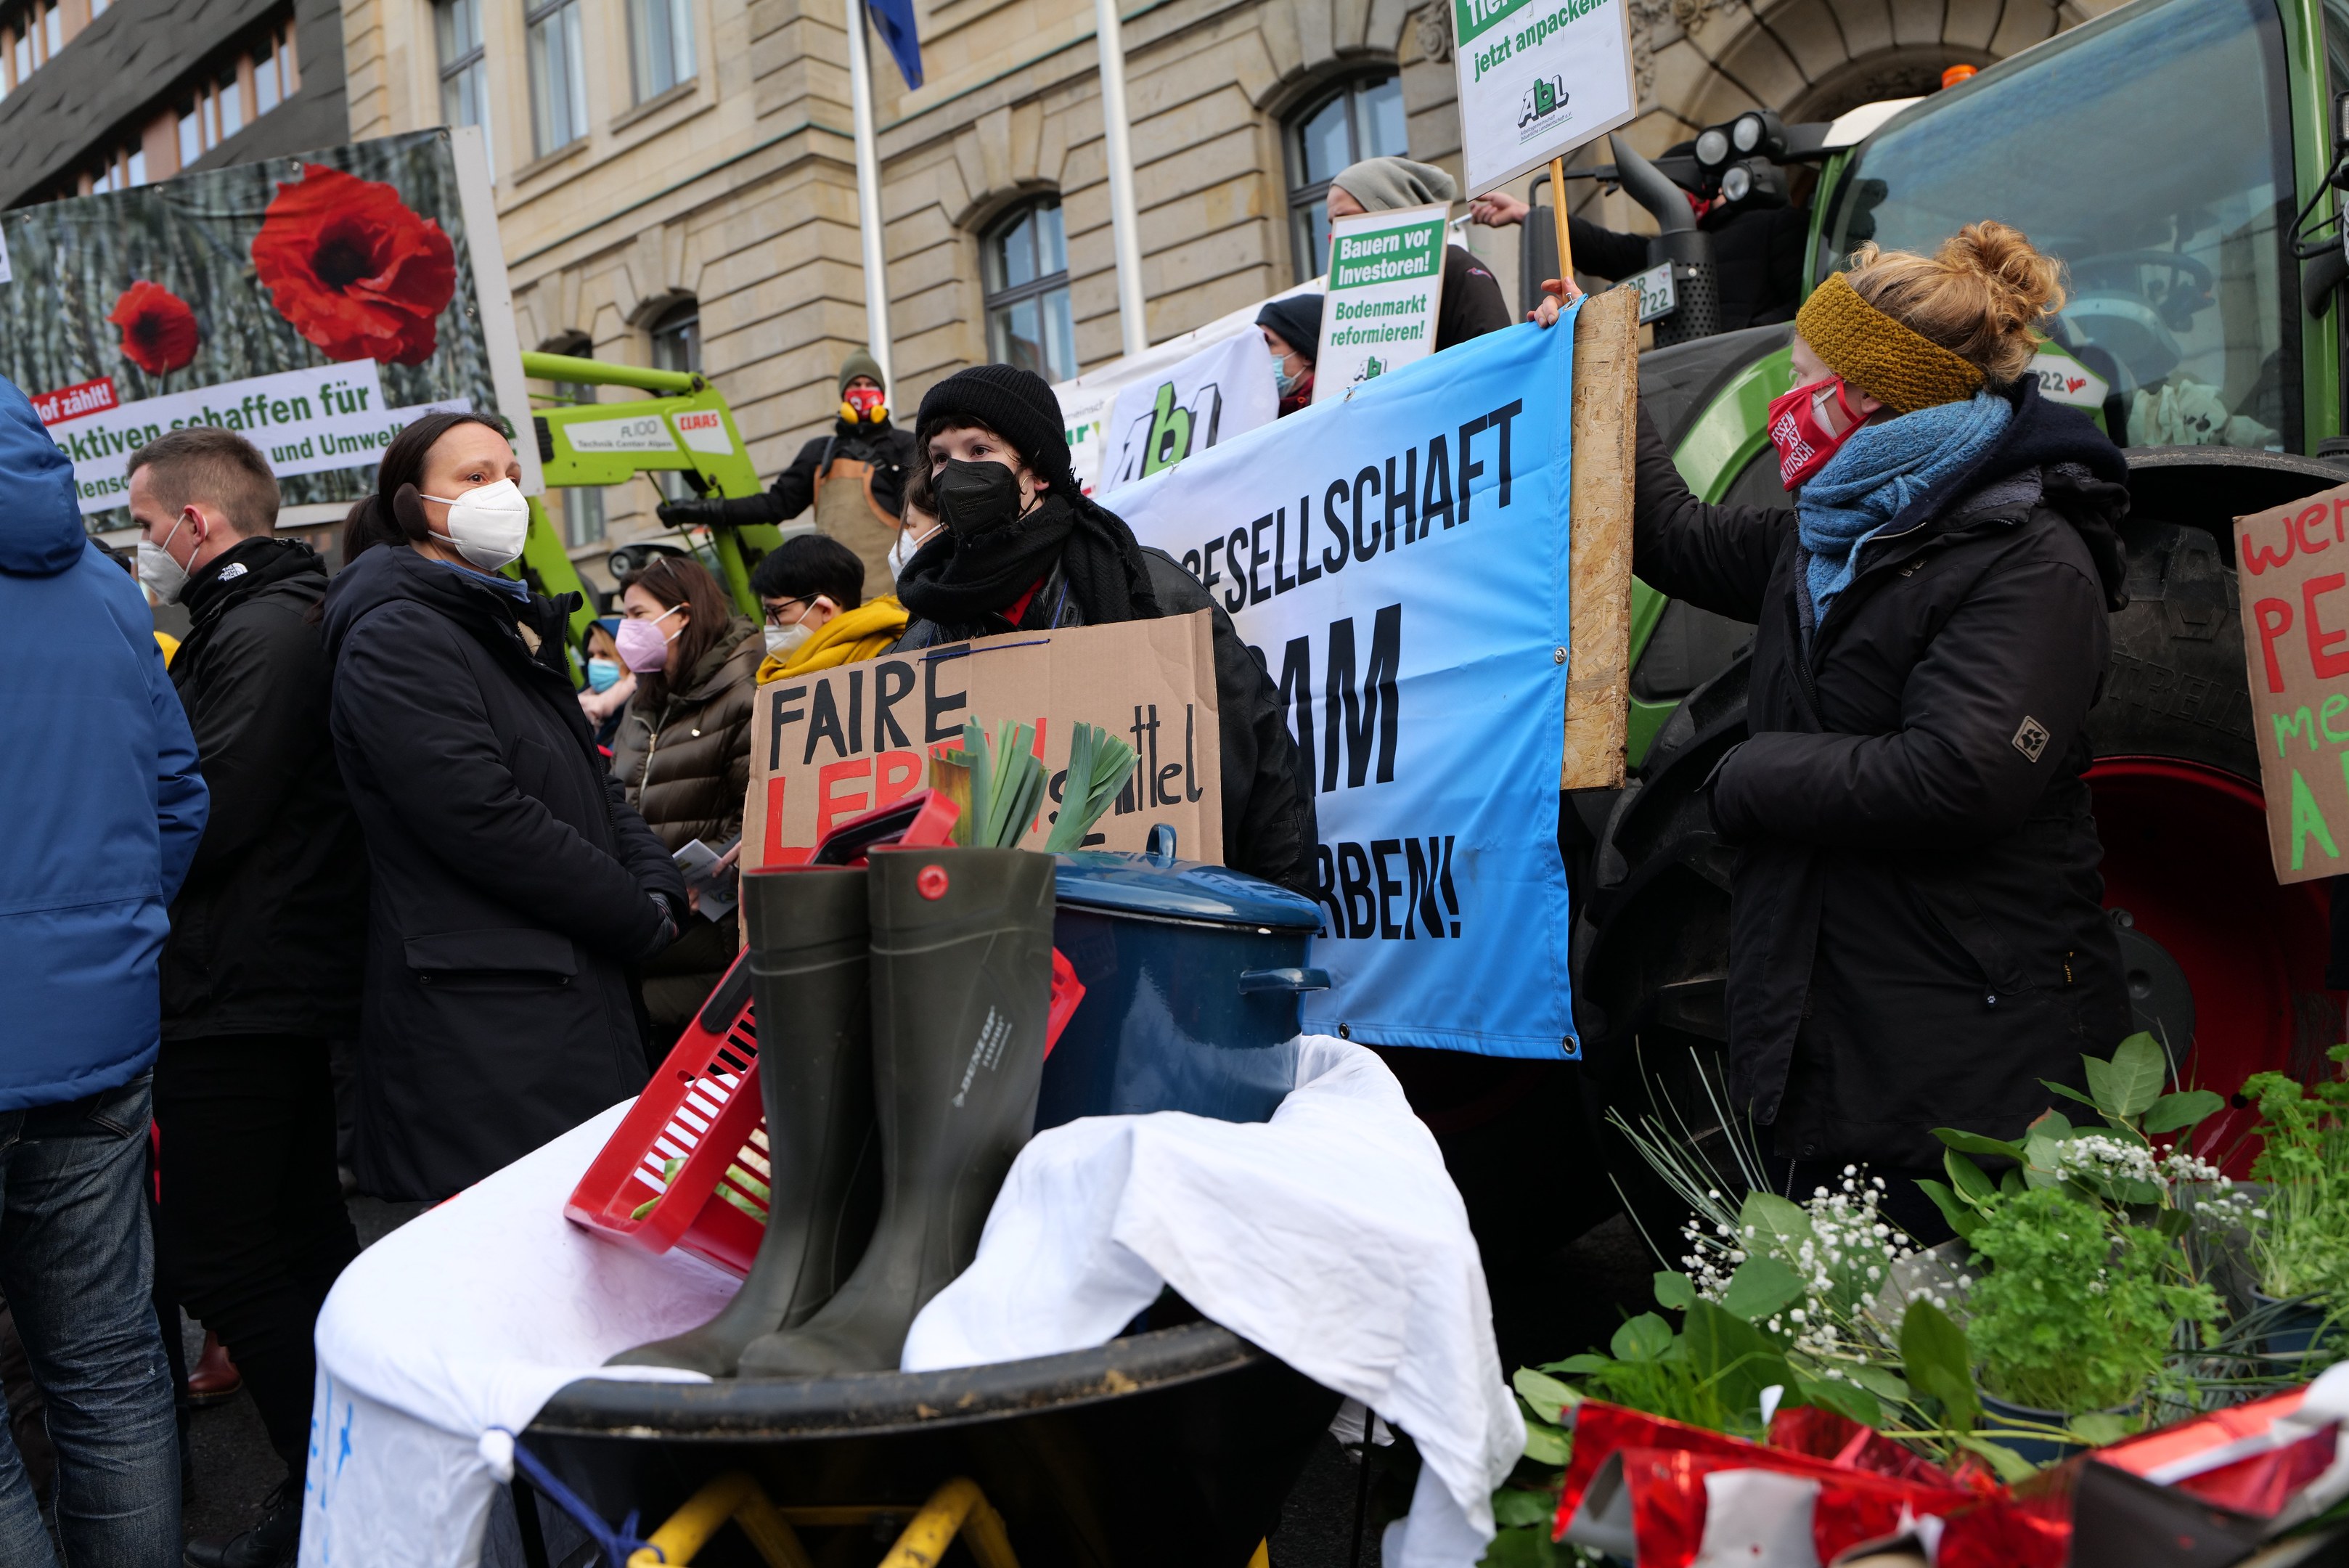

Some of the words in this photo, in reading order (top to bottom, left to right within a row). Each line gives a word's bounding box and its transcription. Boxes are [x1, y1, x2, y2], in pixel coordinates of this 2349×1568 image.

[1474, 36, 1512, 83] jetzt
[1516, 0, 1607, 53] anpacke
[1520, 114, 1556, 136] Arbeitsgemeinschaft
[1539, 115, 1565, 131] Landwirtschaft
[1340, 234, 1400, 261] Bauern
[1405, 228, 1431, 249] vor
[1338, 250, 1431, 286] Investoren!
[1335, 293, 1427, 321] Bodenmarkt
[1640, 287, 1668, 315] 722
[1331, 320, 1425, 347] reformieren!
[2026, 369, 2064, 391] 22
[61, 383, 112, 416] zählt!
[319, 380, 369, 417] für
[679, 413, 719, 431] CLAAS
[1771, 411, 1796, 446] ESSEN
[271, 437, 314, 463] und
[1786, 425, 1802, 449] IST
[769, 643, 971, 771] FAIRE
[960, 1006, 995, 1093] DUNLOP
